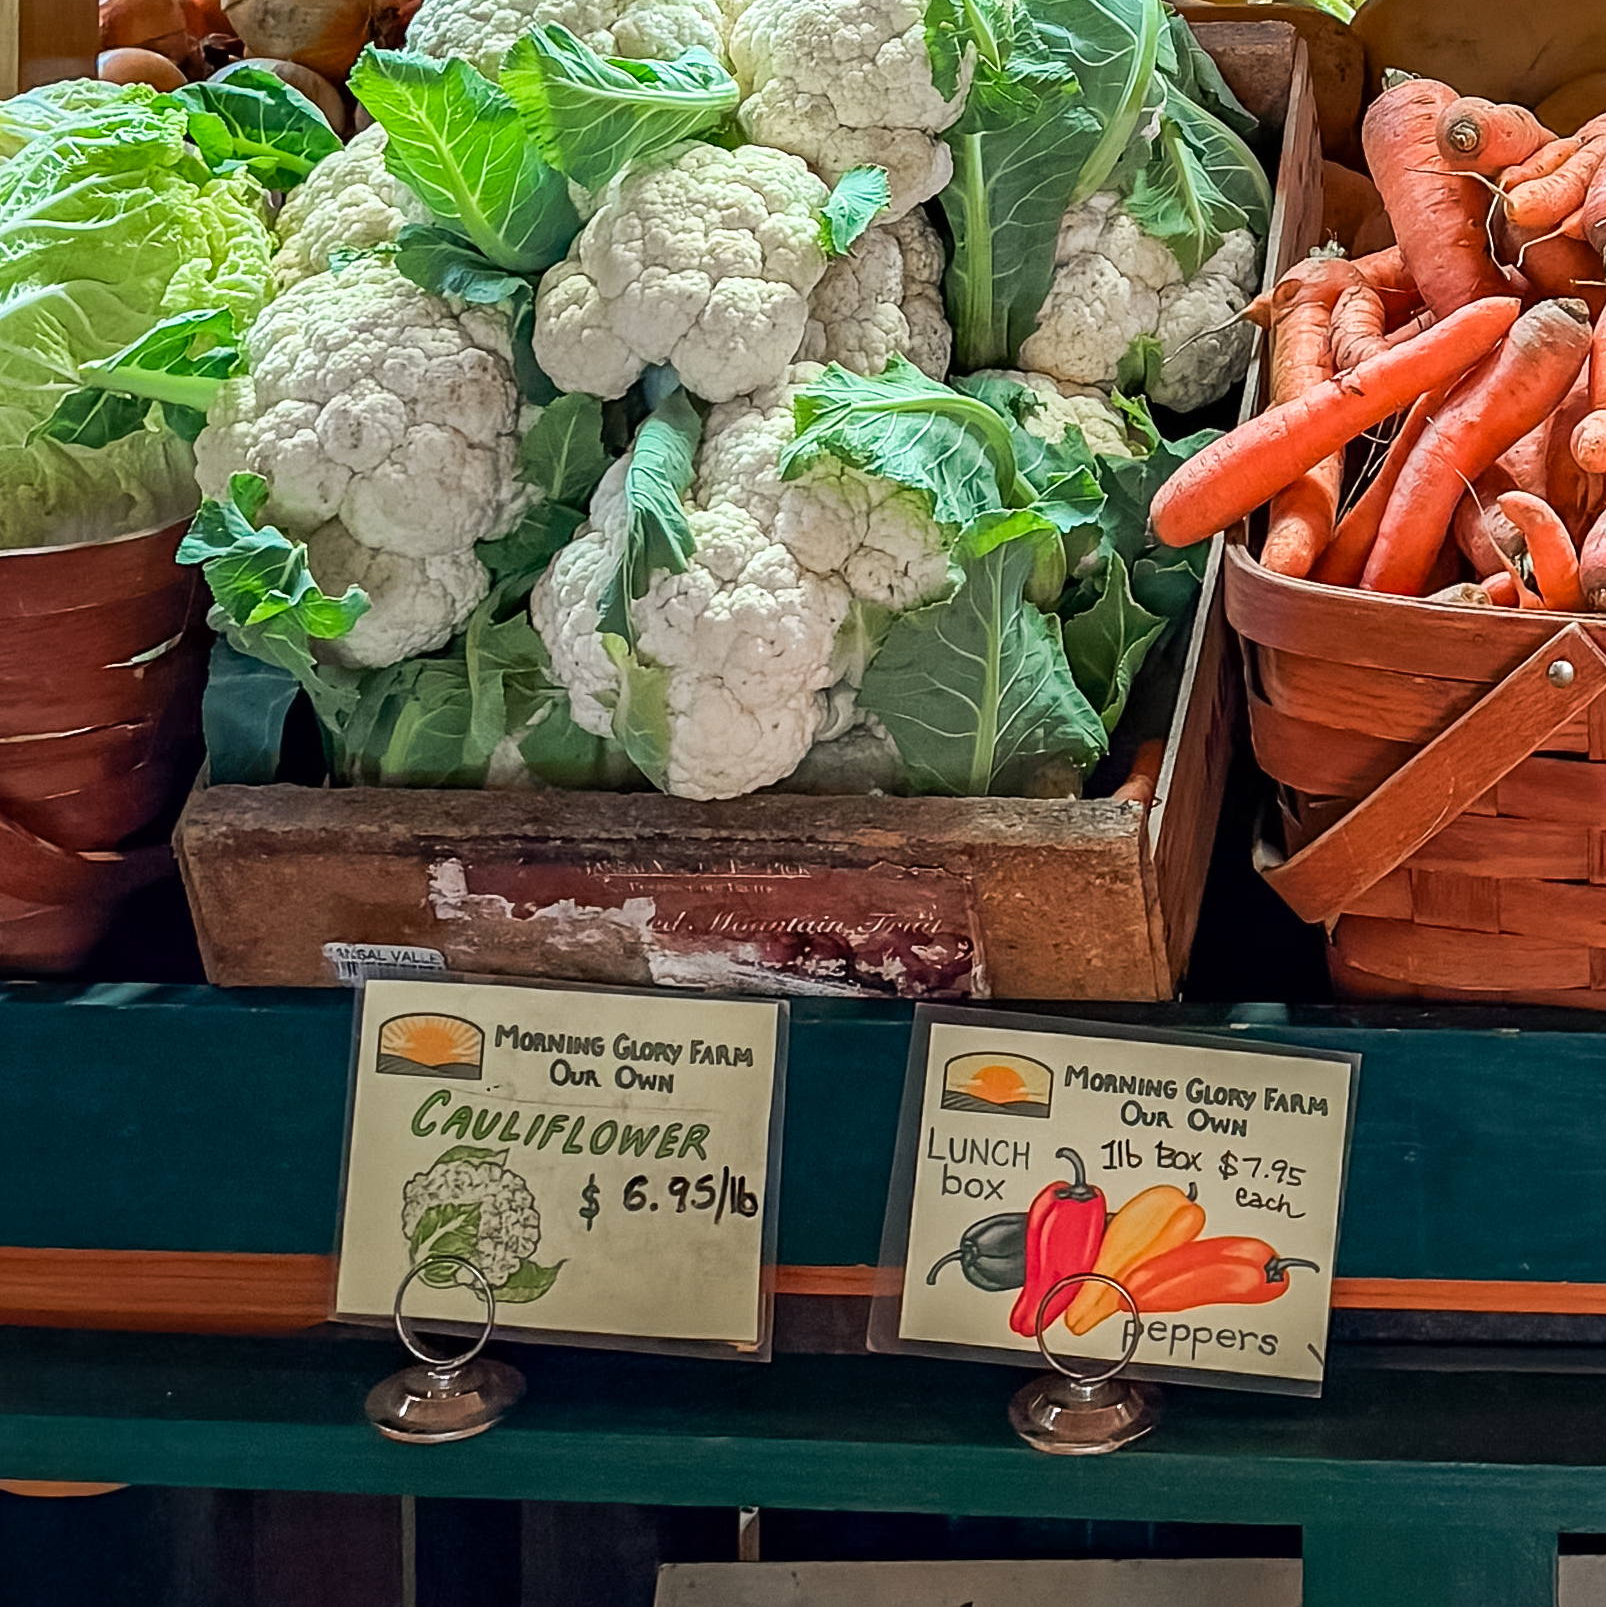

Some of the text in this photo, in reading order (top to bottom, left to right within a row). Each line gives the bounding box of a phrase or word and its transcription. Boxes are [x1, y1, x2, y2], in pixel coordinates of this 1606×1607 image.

[495, 1025, 754, 1068] MORNING GLORY FARM
[550, 1059, 675, 1094] OUR OWN
[1064, 1065, 1329, 1117] MORNING GLORY FARM
[411, 1089, 711, 1161] CAULIFLOWER
[1120, 1100, 1248, 1138] OUR OWN
[927, 1126, 1031, 1171] LUNCH
[941, 1164, 1007, 1200] box
[1218, 1150, 1307, 1187] $7.95
[1235, 1186, 1306, 1218] each
